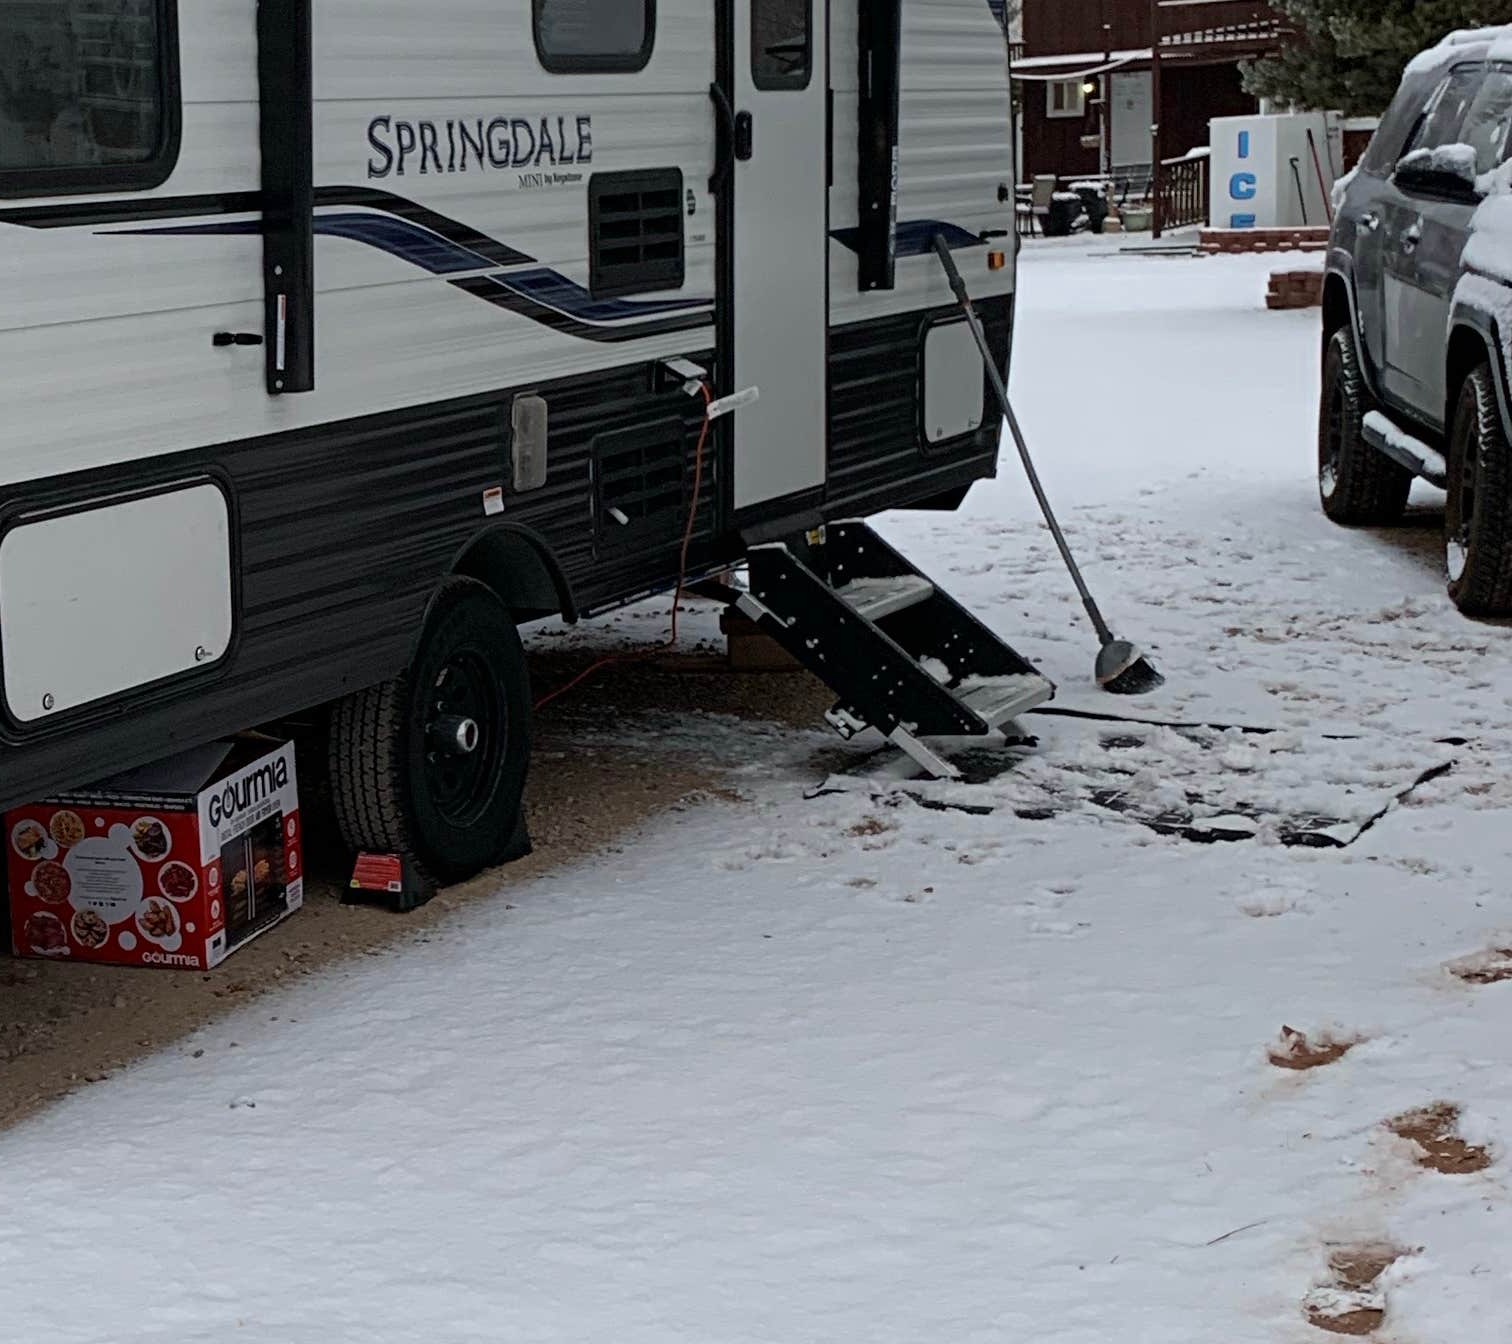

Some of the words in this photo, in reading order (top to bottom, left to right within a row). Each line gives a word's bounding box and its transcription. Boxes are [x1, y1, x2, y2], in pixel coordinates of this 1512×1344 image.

[367, 115, 592, 179] SPRINGDALE
[209, 756, 288, 828] Gourmia
[142, 951, 200, 967] Gourmia
